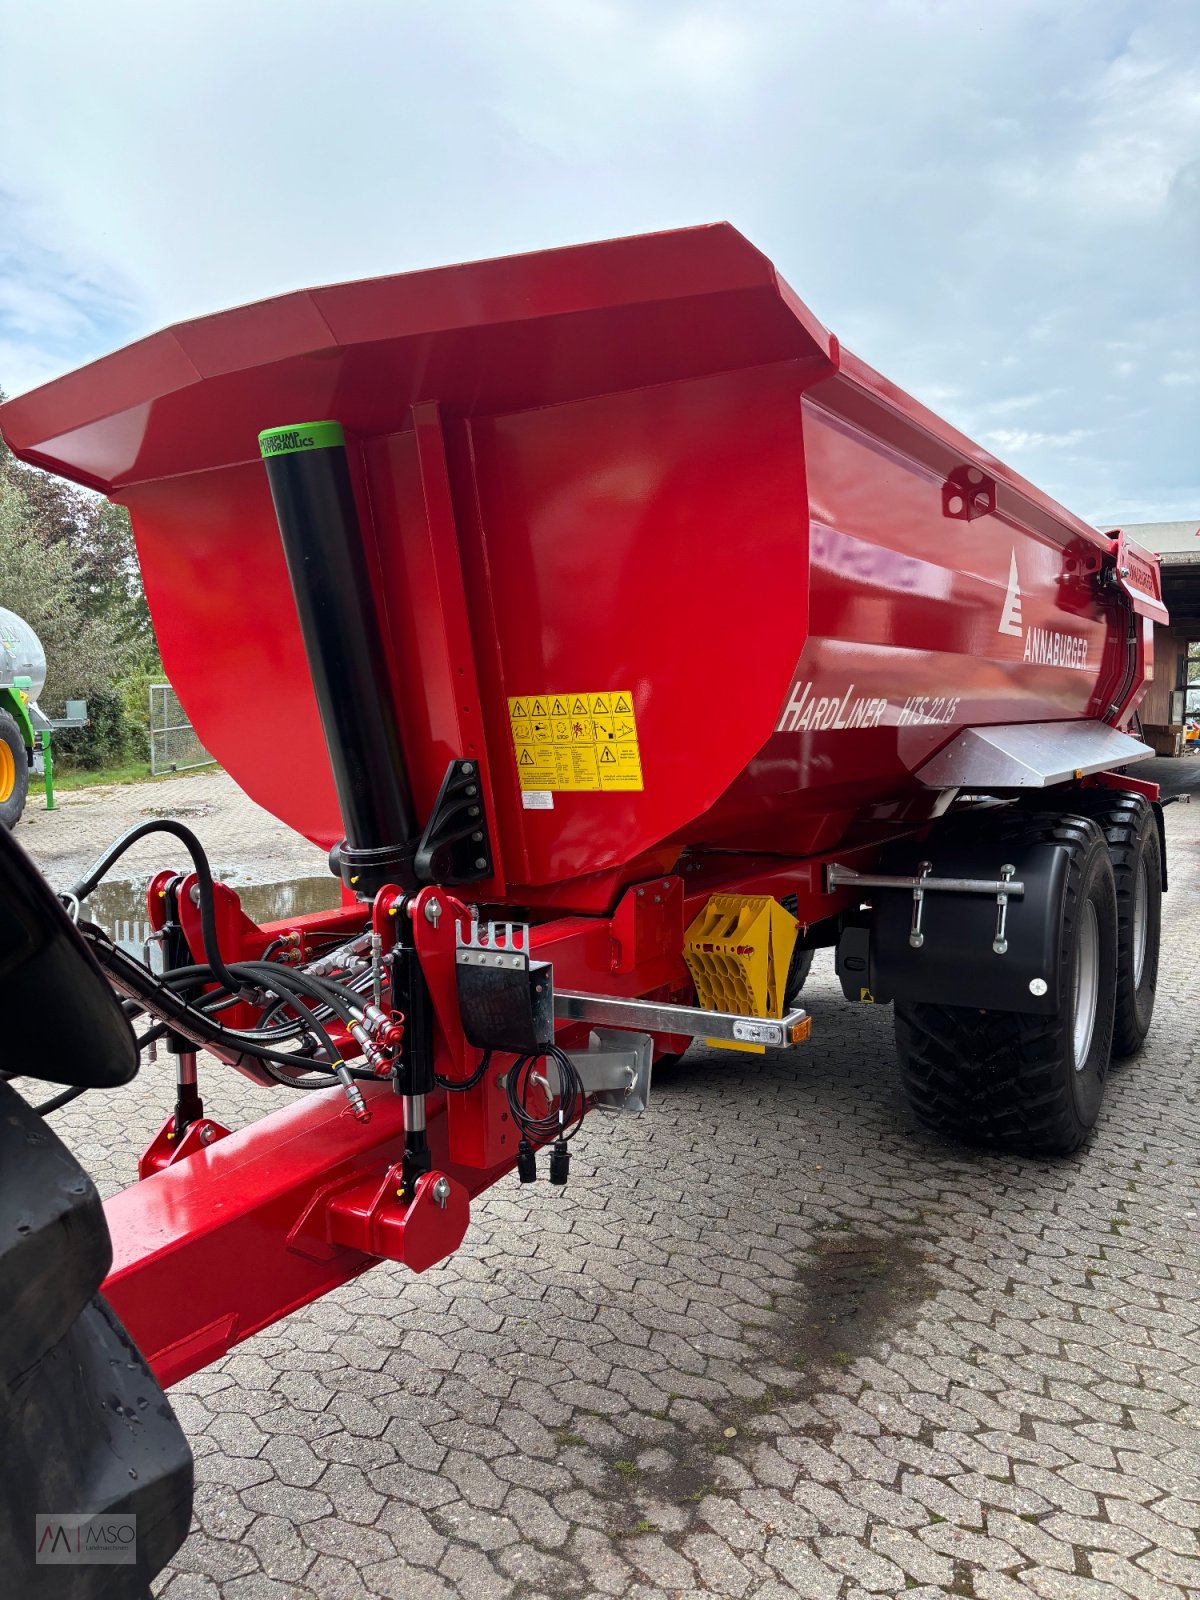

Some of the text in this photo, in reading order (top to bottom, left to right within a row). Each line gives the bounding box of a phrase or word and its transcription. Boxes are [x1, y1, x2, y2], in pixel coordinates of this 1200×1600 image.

[259, 431, 300, 448] NTERPUMP
[263, 437, 314, 454] HYDRAULICS
[1022, 625, 1088, 670] ANNABURGER
[896, 696, 930, 726] HTS
[922, 697, 961, 725] 22.15
